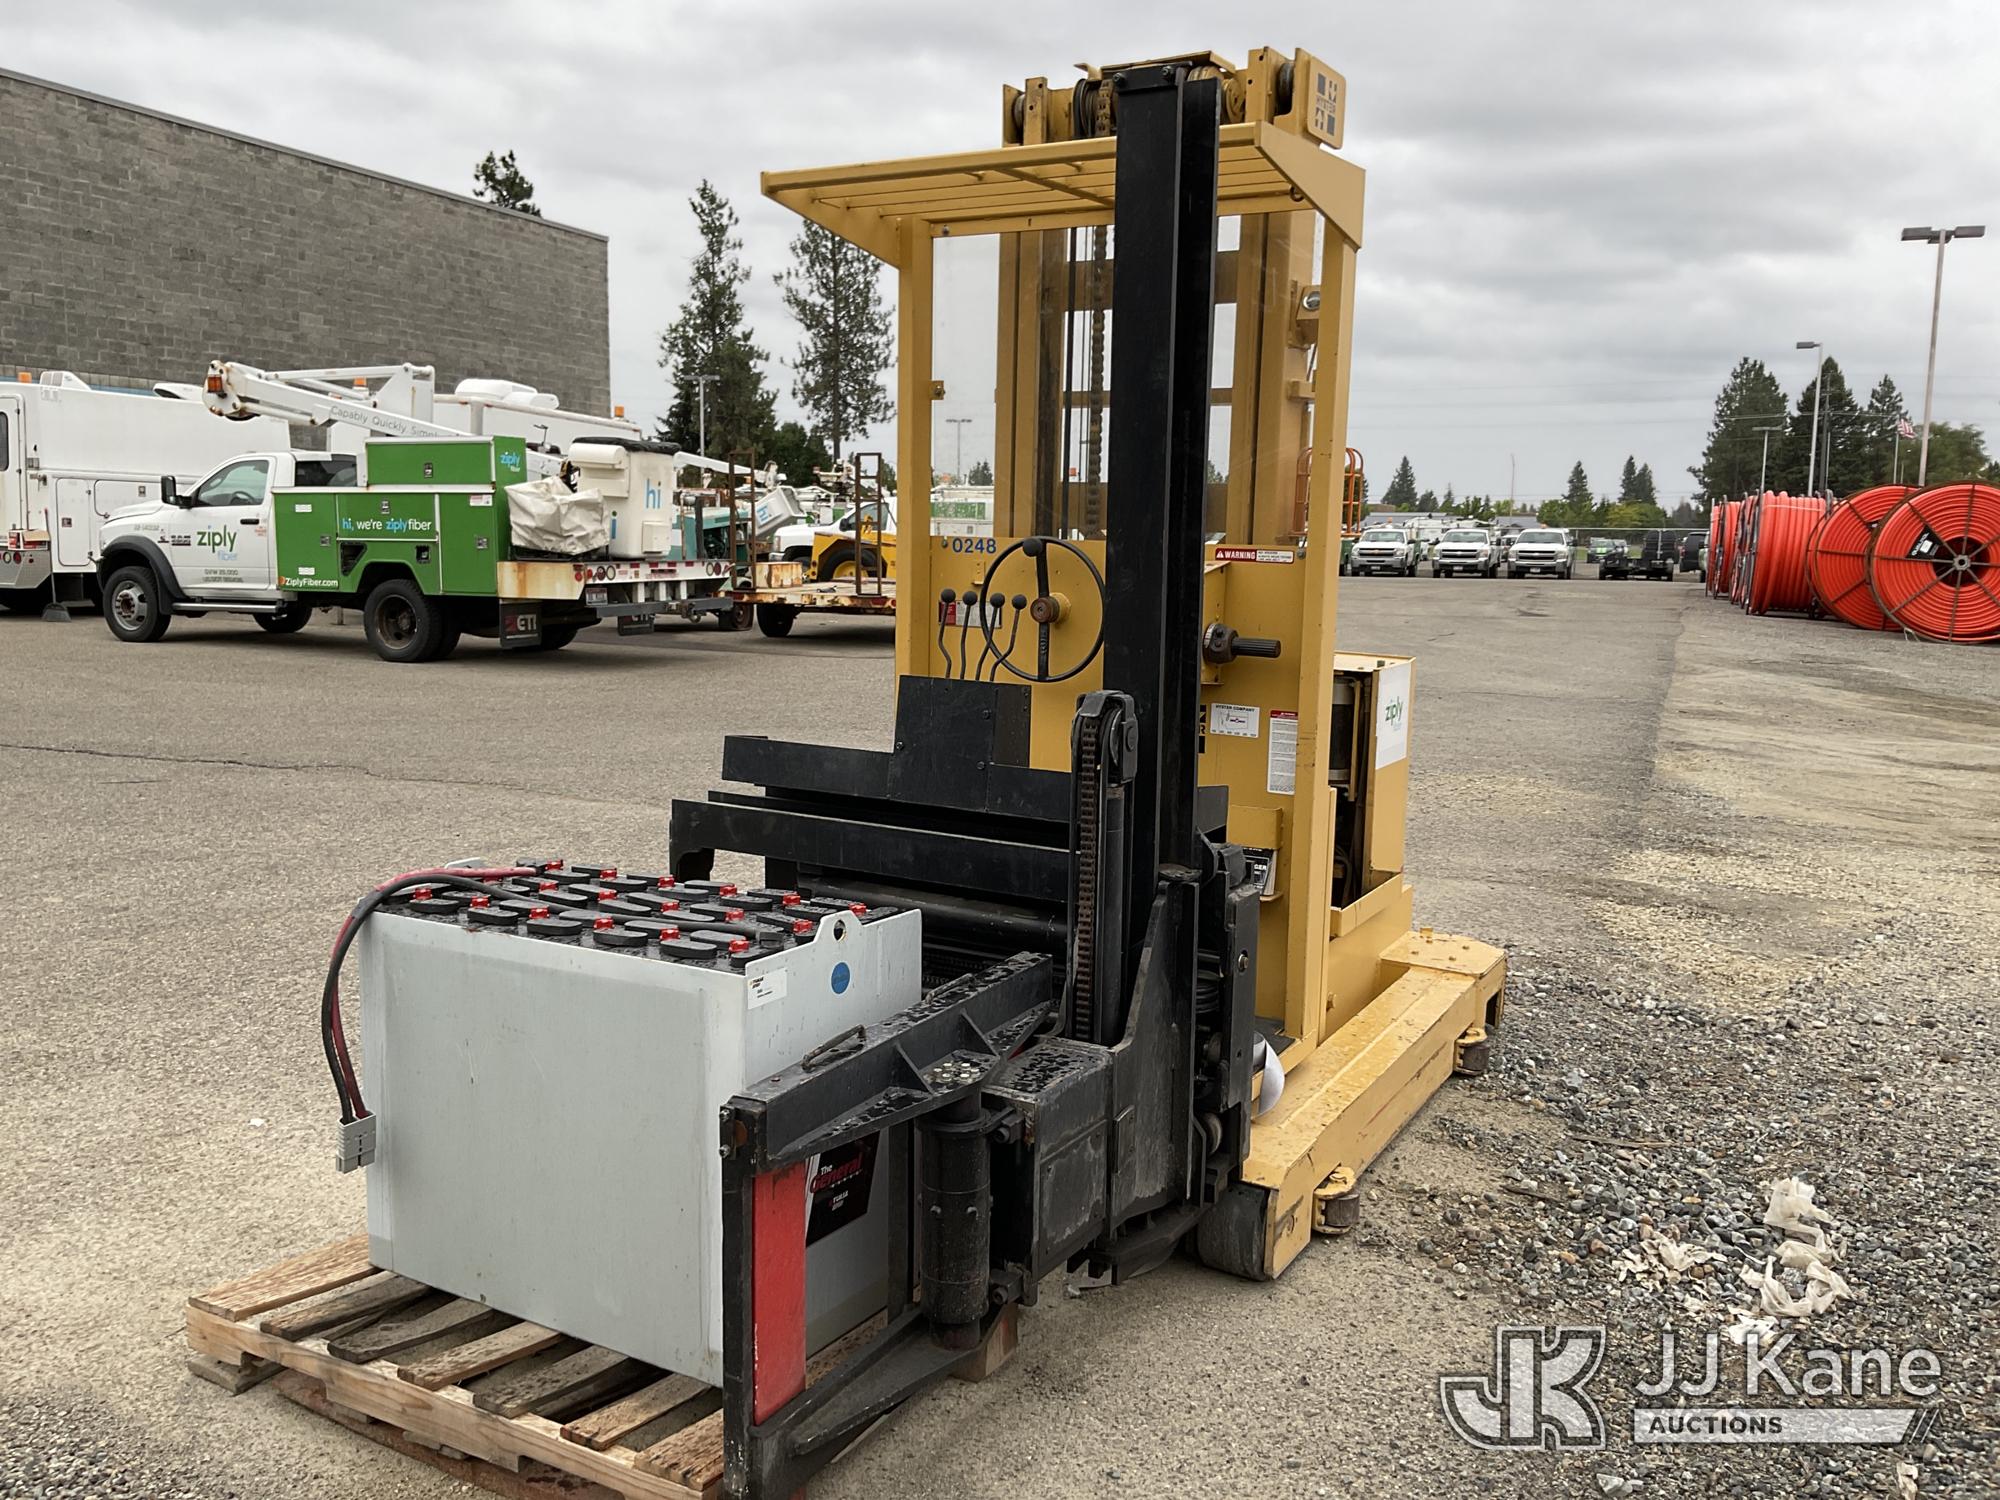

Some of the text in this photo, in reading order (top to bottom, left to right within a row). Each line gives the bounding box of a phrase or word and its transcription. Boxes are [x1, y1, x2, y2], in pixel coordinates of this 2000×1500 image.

[331, 406, 368, 423] Capably
[372, 416, 407, 434] Quickly
[500, 452, 520, 469] ziply
[646, 478, 661, 509] hi
[356, 517, 383, 530] we're
[197, 525, 237, 553] ziply
[952, 537, 997, 554] 0248
[1225, 550, 1256, 560] WARNING
[284, 577, 339, 588] ZiplyFiber.com
[1385, 696, 1404, 726] ziply
